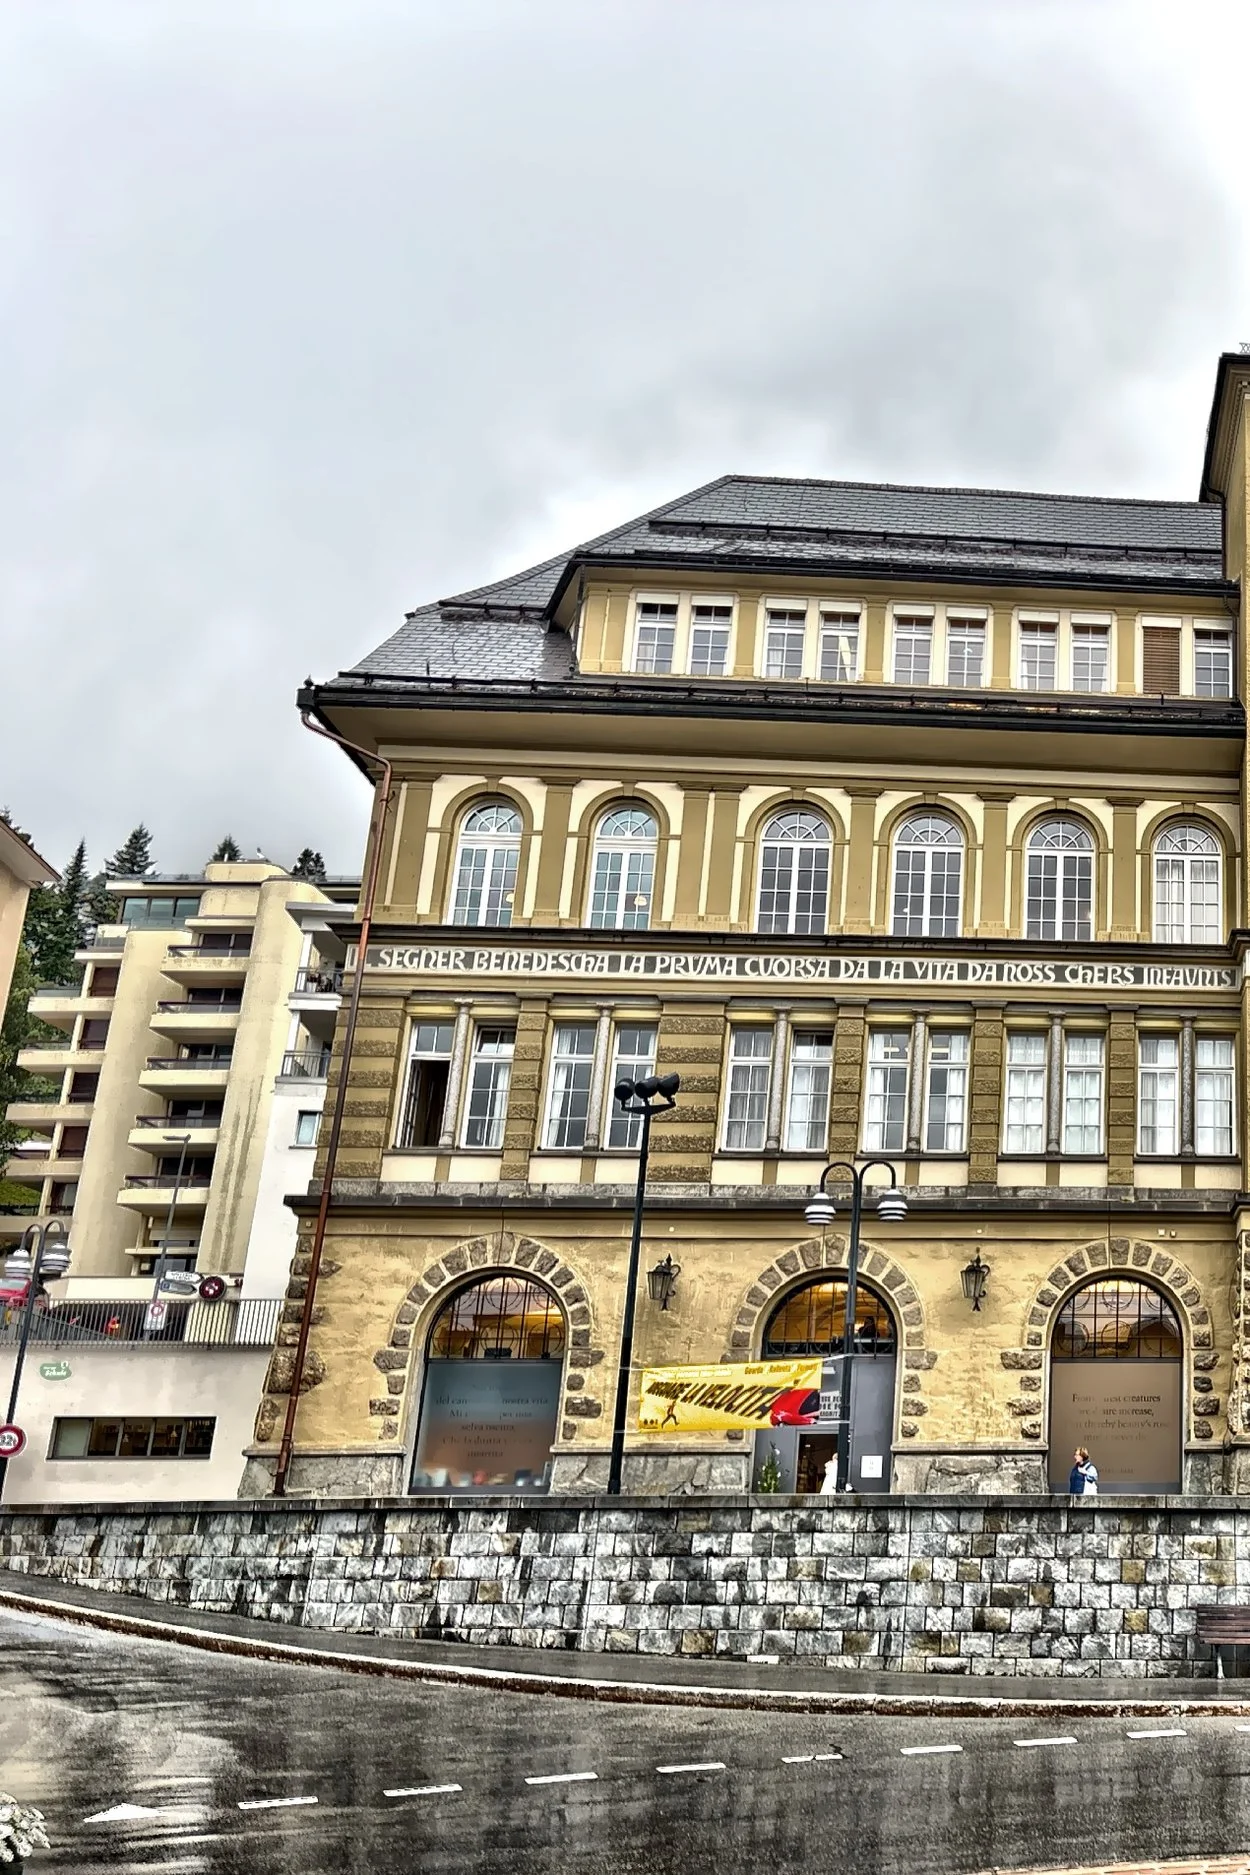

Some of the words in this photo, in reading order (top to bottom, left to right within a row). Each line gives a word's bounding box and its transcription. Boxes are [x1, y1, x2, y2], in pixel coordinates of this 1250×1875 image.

[618, 954, 646, 973] LA
[744, 956, 830, 979] CUORSA
[837, 959, 870, 979] DA
[879, 960, 904, 980] LA
[910, 961, 959, 981] VITA
[966, 962, 997, 982] DA
